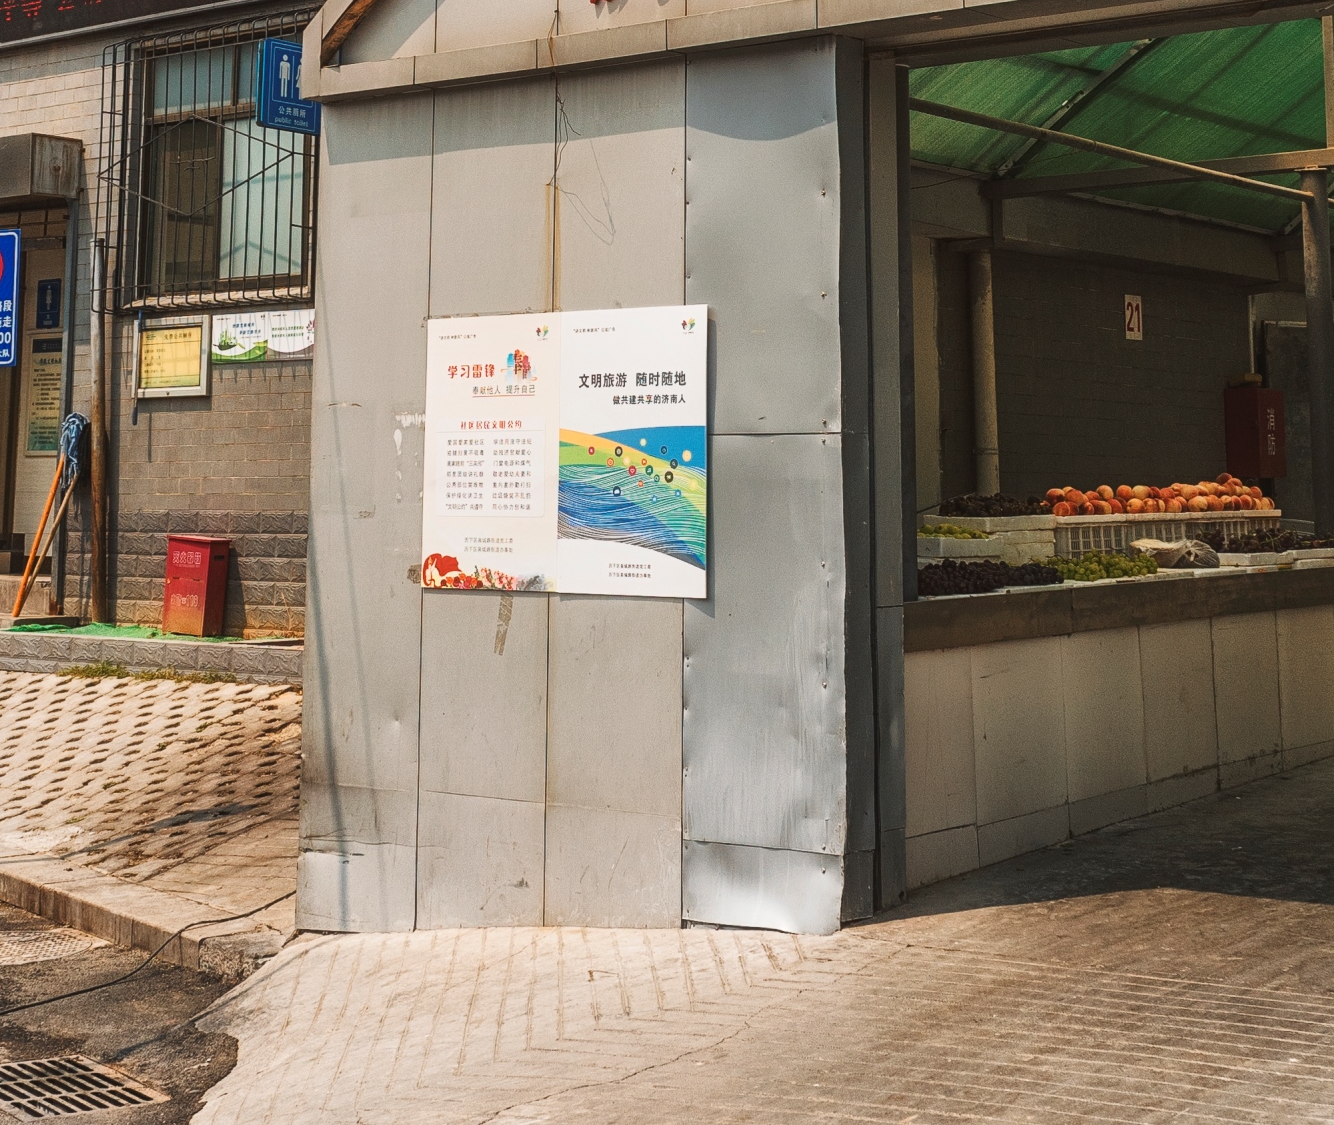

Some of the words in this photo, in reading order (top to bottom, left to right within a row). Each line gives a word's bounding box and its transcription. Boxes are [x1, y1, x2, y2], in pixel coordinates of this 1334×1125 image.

[278, 106, 306, 118] 公共厕所
[1126, 301, 1141, 332] 21
[447, 364, 495, 378] 学习雷锋
[579, 372, 627, 388] 文明旅游
[636, 370, 686, 387] 随时随地
[472, 385, 501, 395] 奉献他人
[506, 384, 536, 394] 提升自己
[613, 394, 686, 405] 做共建共享的济南人
[460, 420, 522, 430] 社区居民文明公约
[1266, 407, 1276, 456] 消防
[173, 551, 201, 564] 灭火器箱
